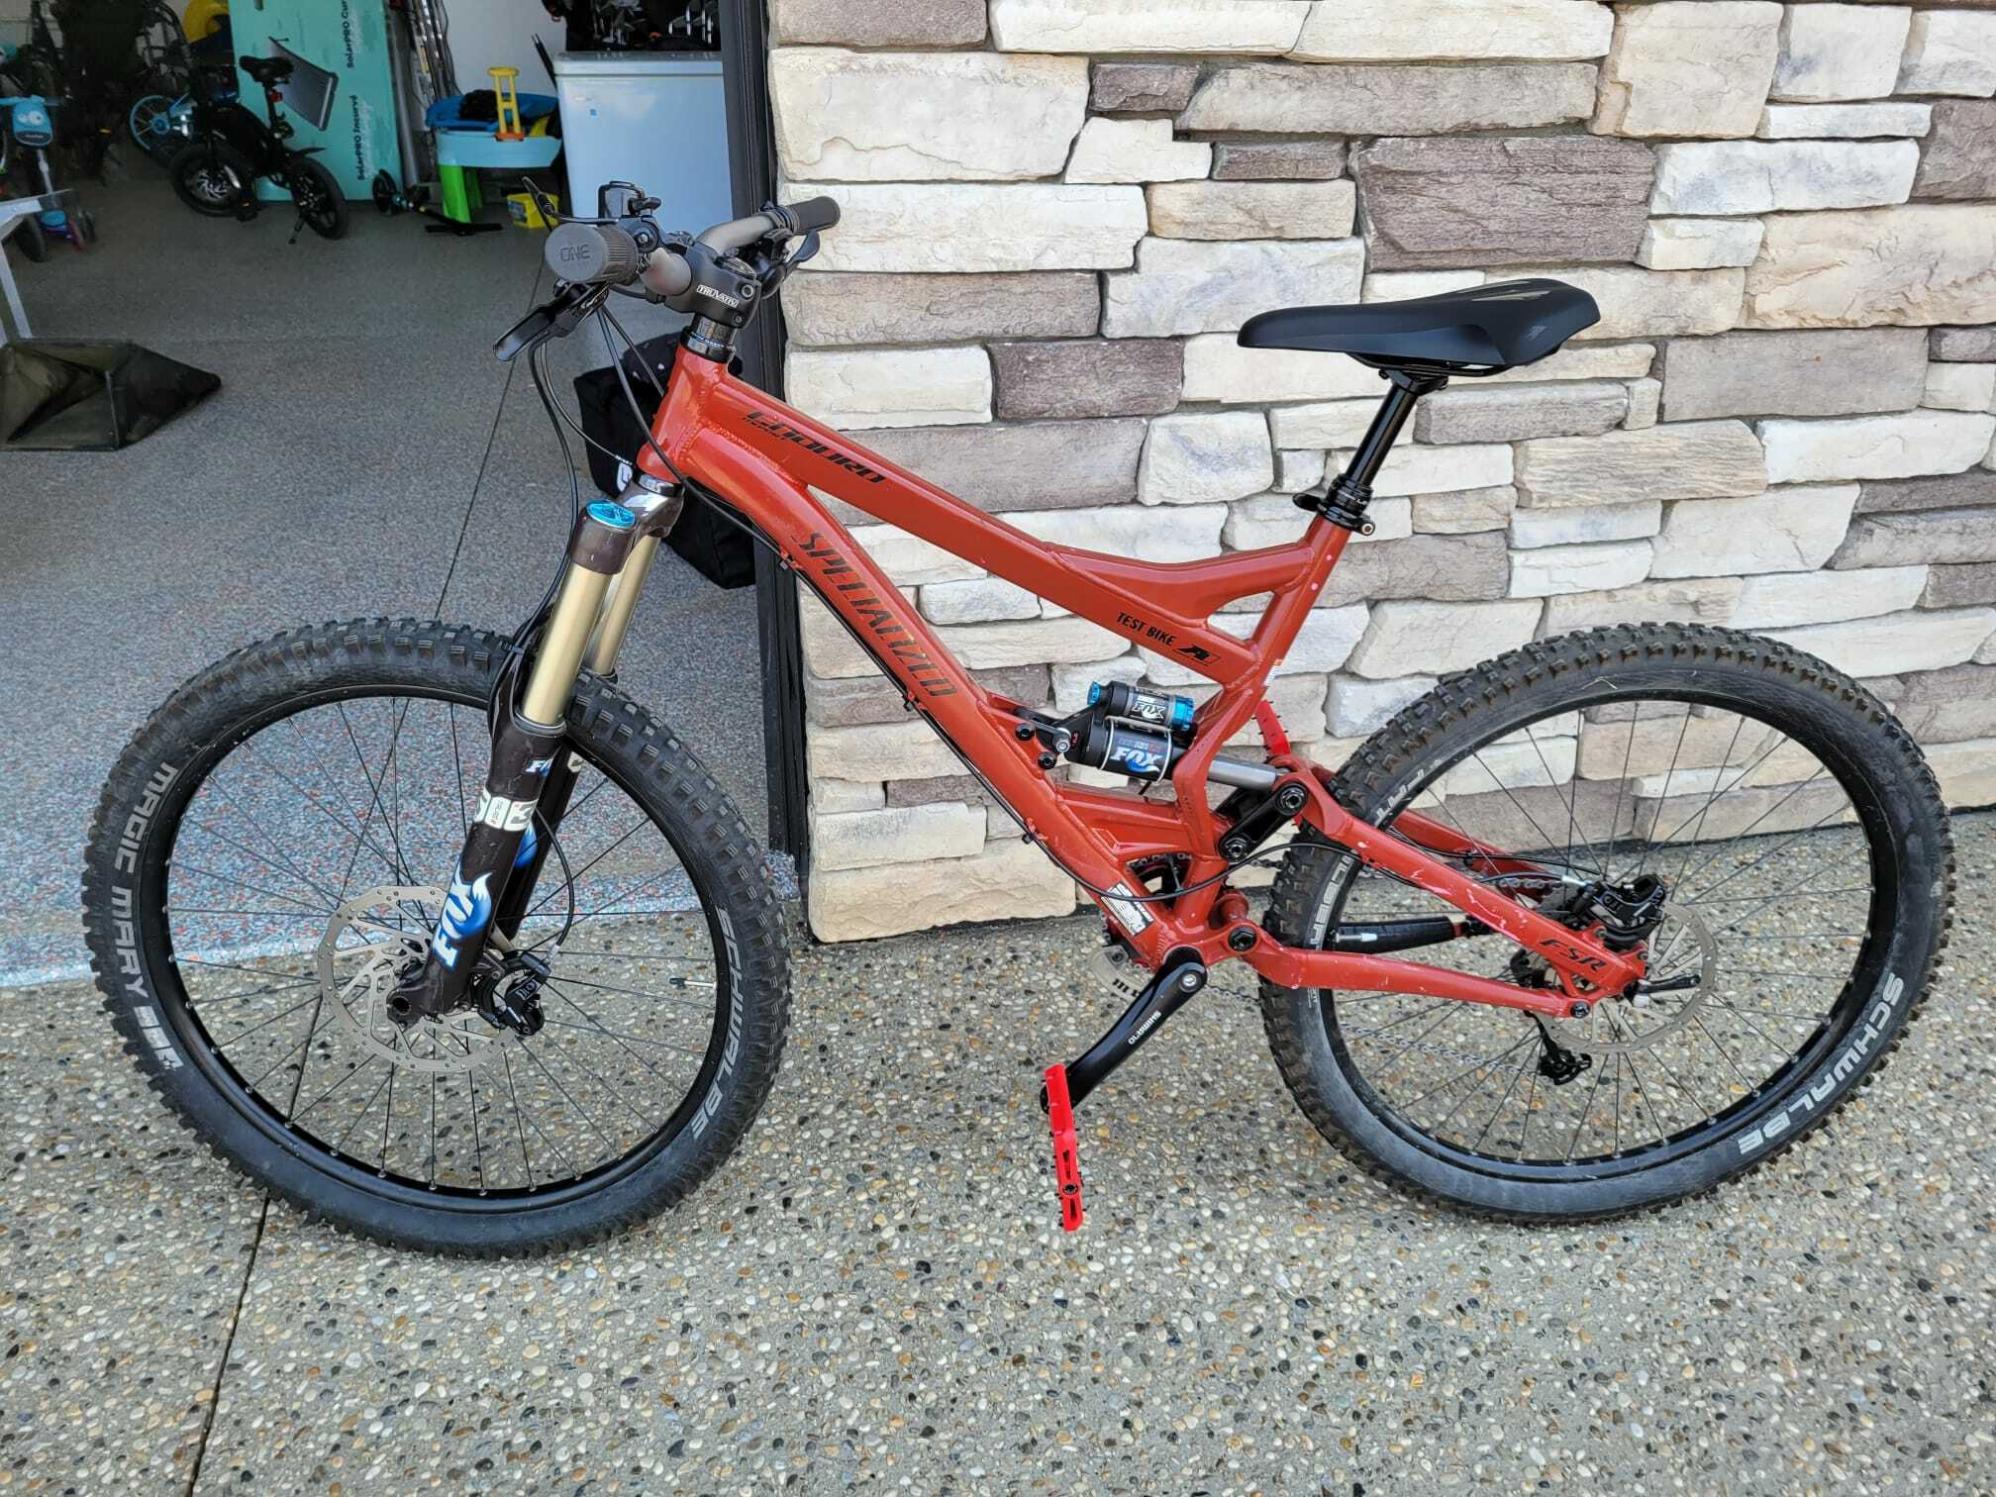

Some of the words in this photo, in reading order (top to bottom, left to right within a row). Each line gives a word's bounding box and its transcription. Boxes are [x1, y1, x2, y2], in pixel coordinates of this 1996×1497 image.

[1116, 612, 1147, 632] TEST
[1146, 626, 1177, 646] BIKE
[1110, 747, 1163, 767] FOX
[1131, 702, 1167, 719] FOX
[114, 762, 178, 875] MAGIC
[111, 885, 149, 998] MARY
[432, 856, 475, 968] FOX
[1540, 938, 1607, 972] FSR
[691, 904, 743, 1140] SCHWALBE
[1738, 971, 1904, 1155] SCHWALBE
